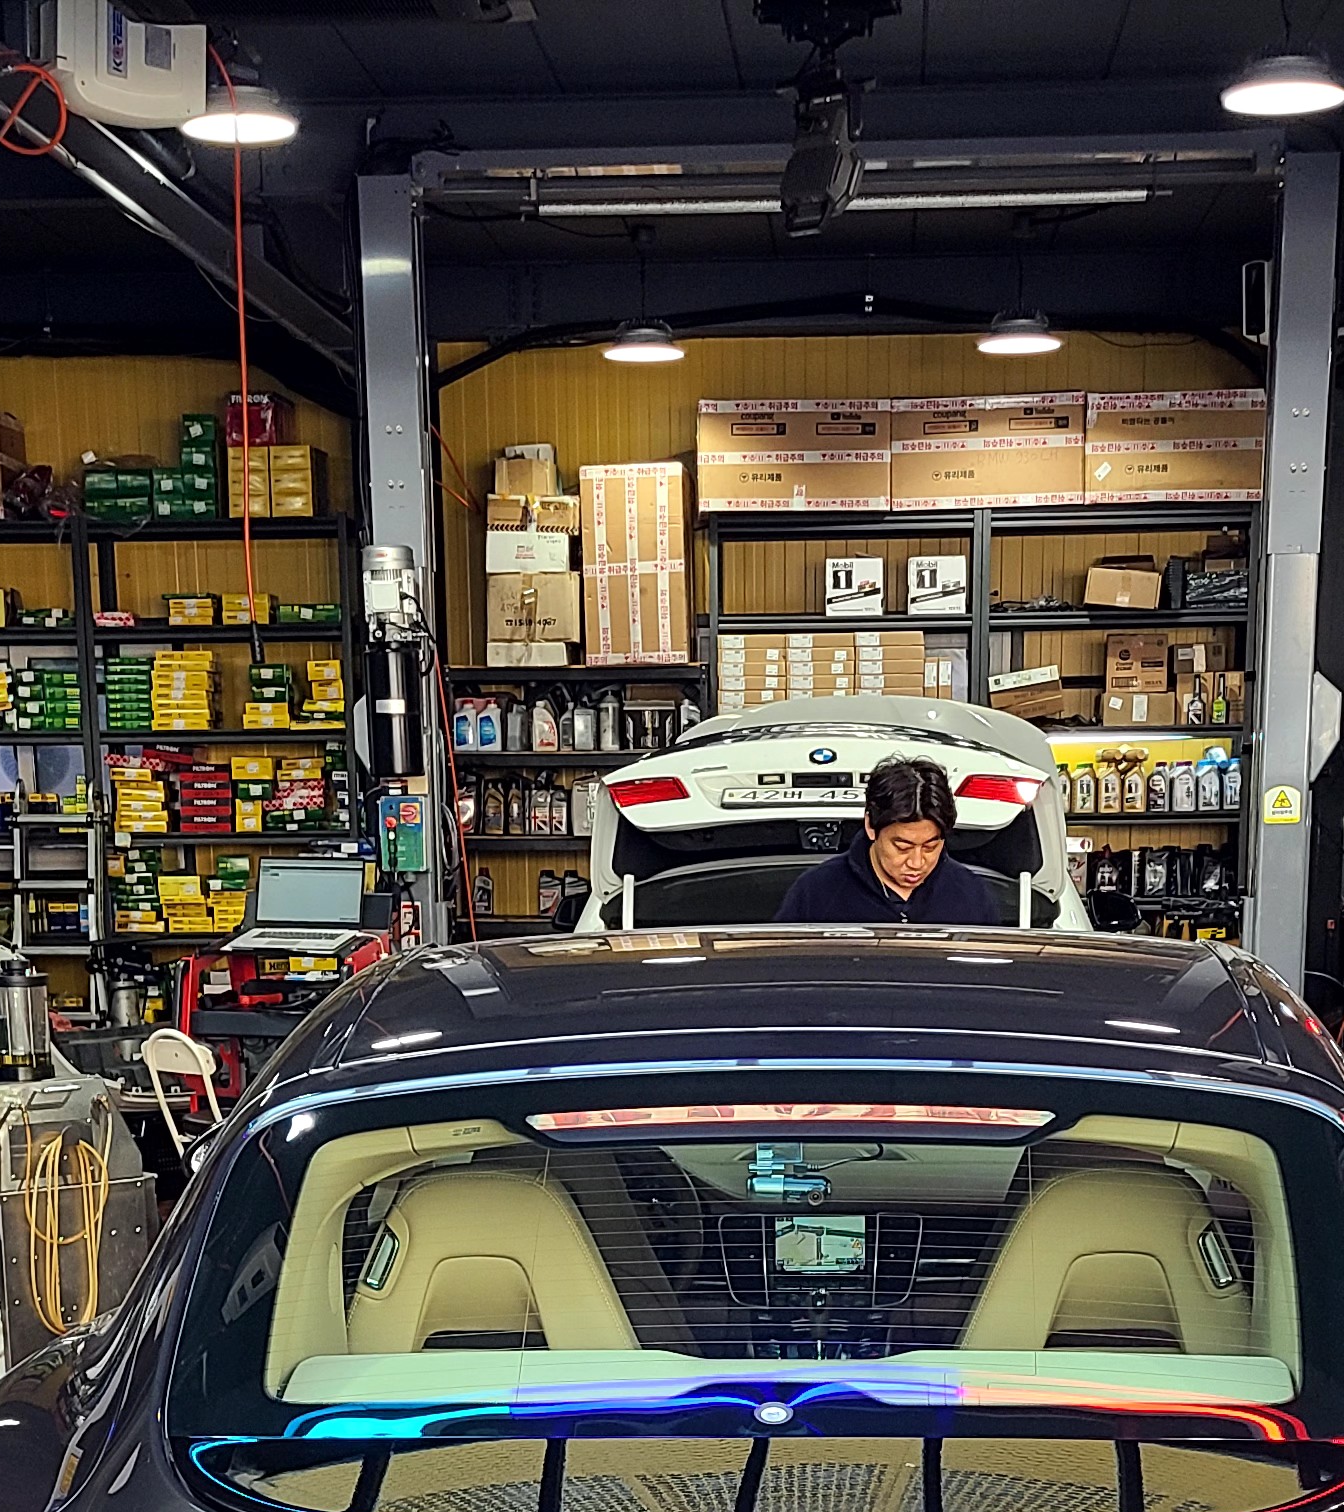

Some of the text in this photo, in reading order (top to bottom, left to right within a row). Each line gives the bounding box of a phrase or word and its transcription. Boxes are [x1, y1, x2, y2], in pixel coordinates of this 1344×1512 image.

[768, 402, 798, 410] 취급주의
[848, 402, 878, 410] 취급주의
[775, 453, 804, 462] 취급주의
[854, 452, 884, 461] 취급주의
[760, 499, 789, 507] 취급주의
[840, 499, 869, 507] 취급주의
